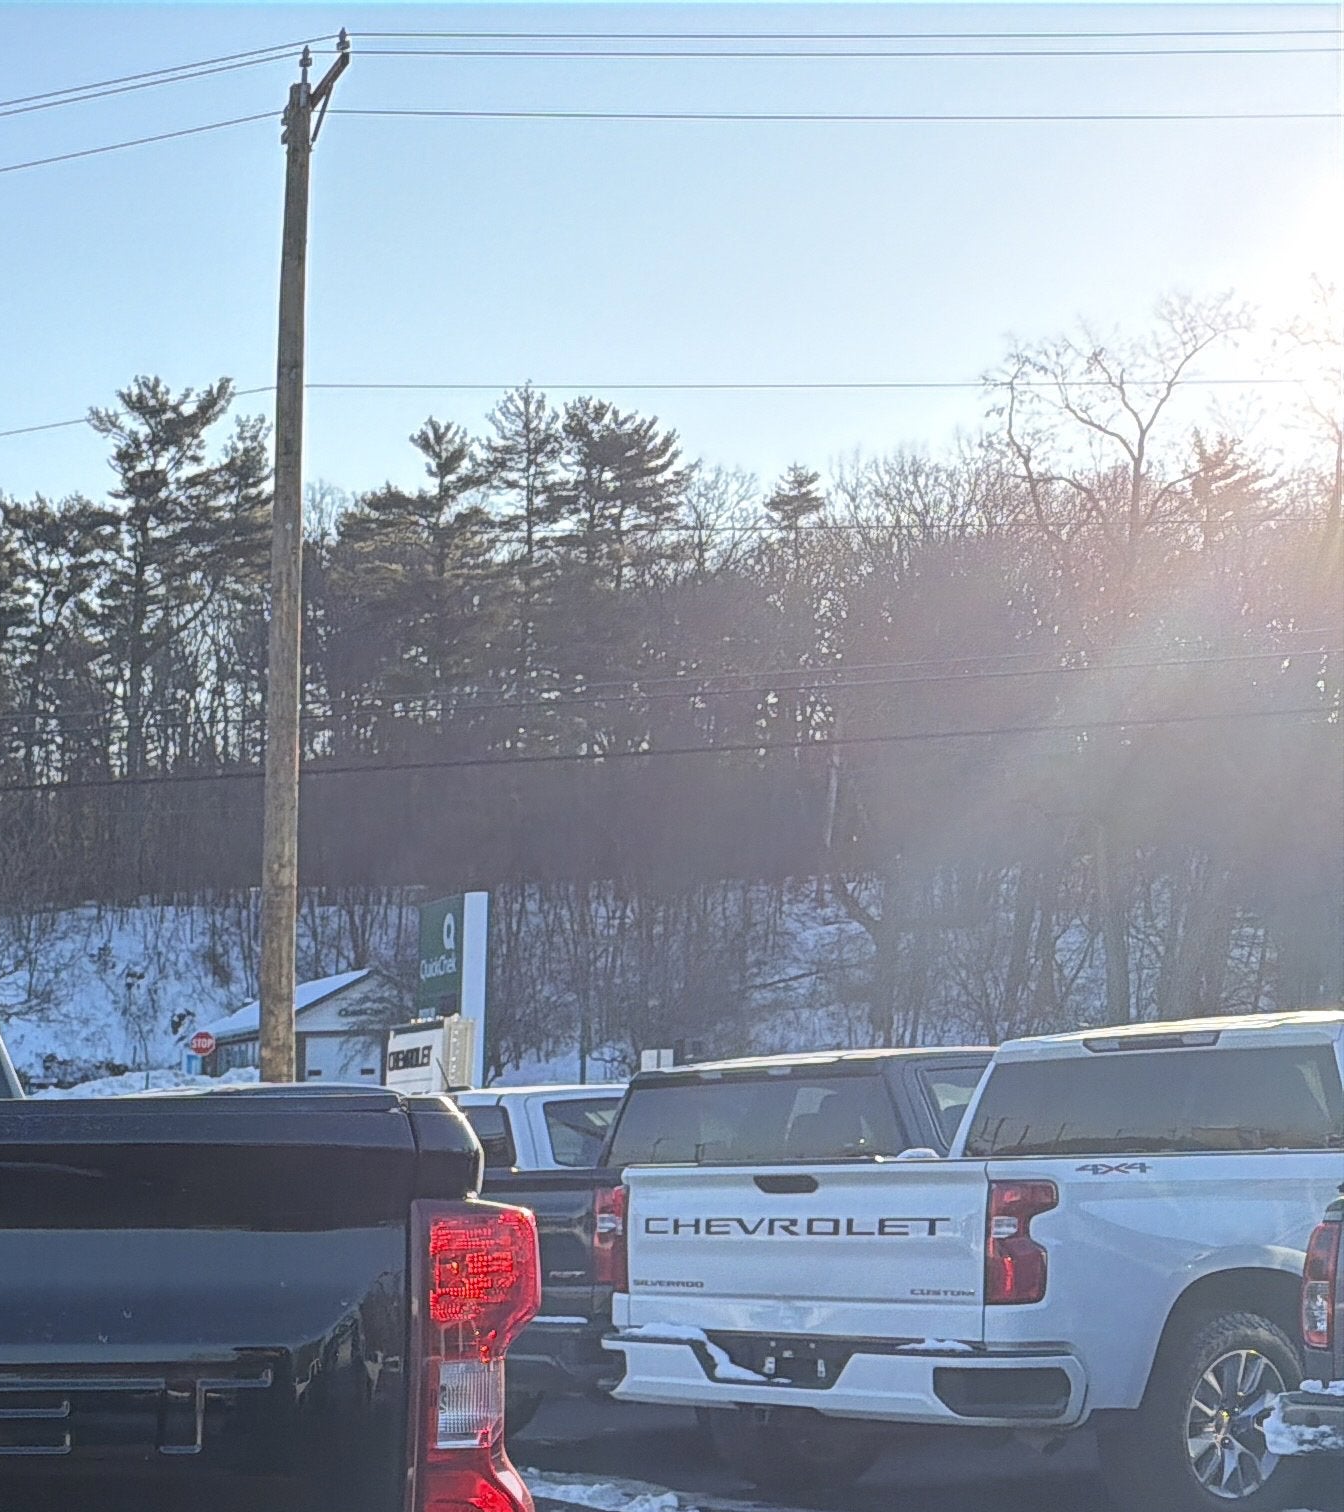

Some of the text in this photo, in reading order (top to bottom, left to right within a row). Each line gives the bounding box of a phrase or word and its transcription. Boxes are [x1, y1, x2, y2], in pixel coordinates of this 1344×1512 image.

[192, 1038, 214, 1049] STOP
[644, 1217, 951, 1236] CHEVROLET
[633, 1279, 976, 1297] SILVERADO CUSTOM
